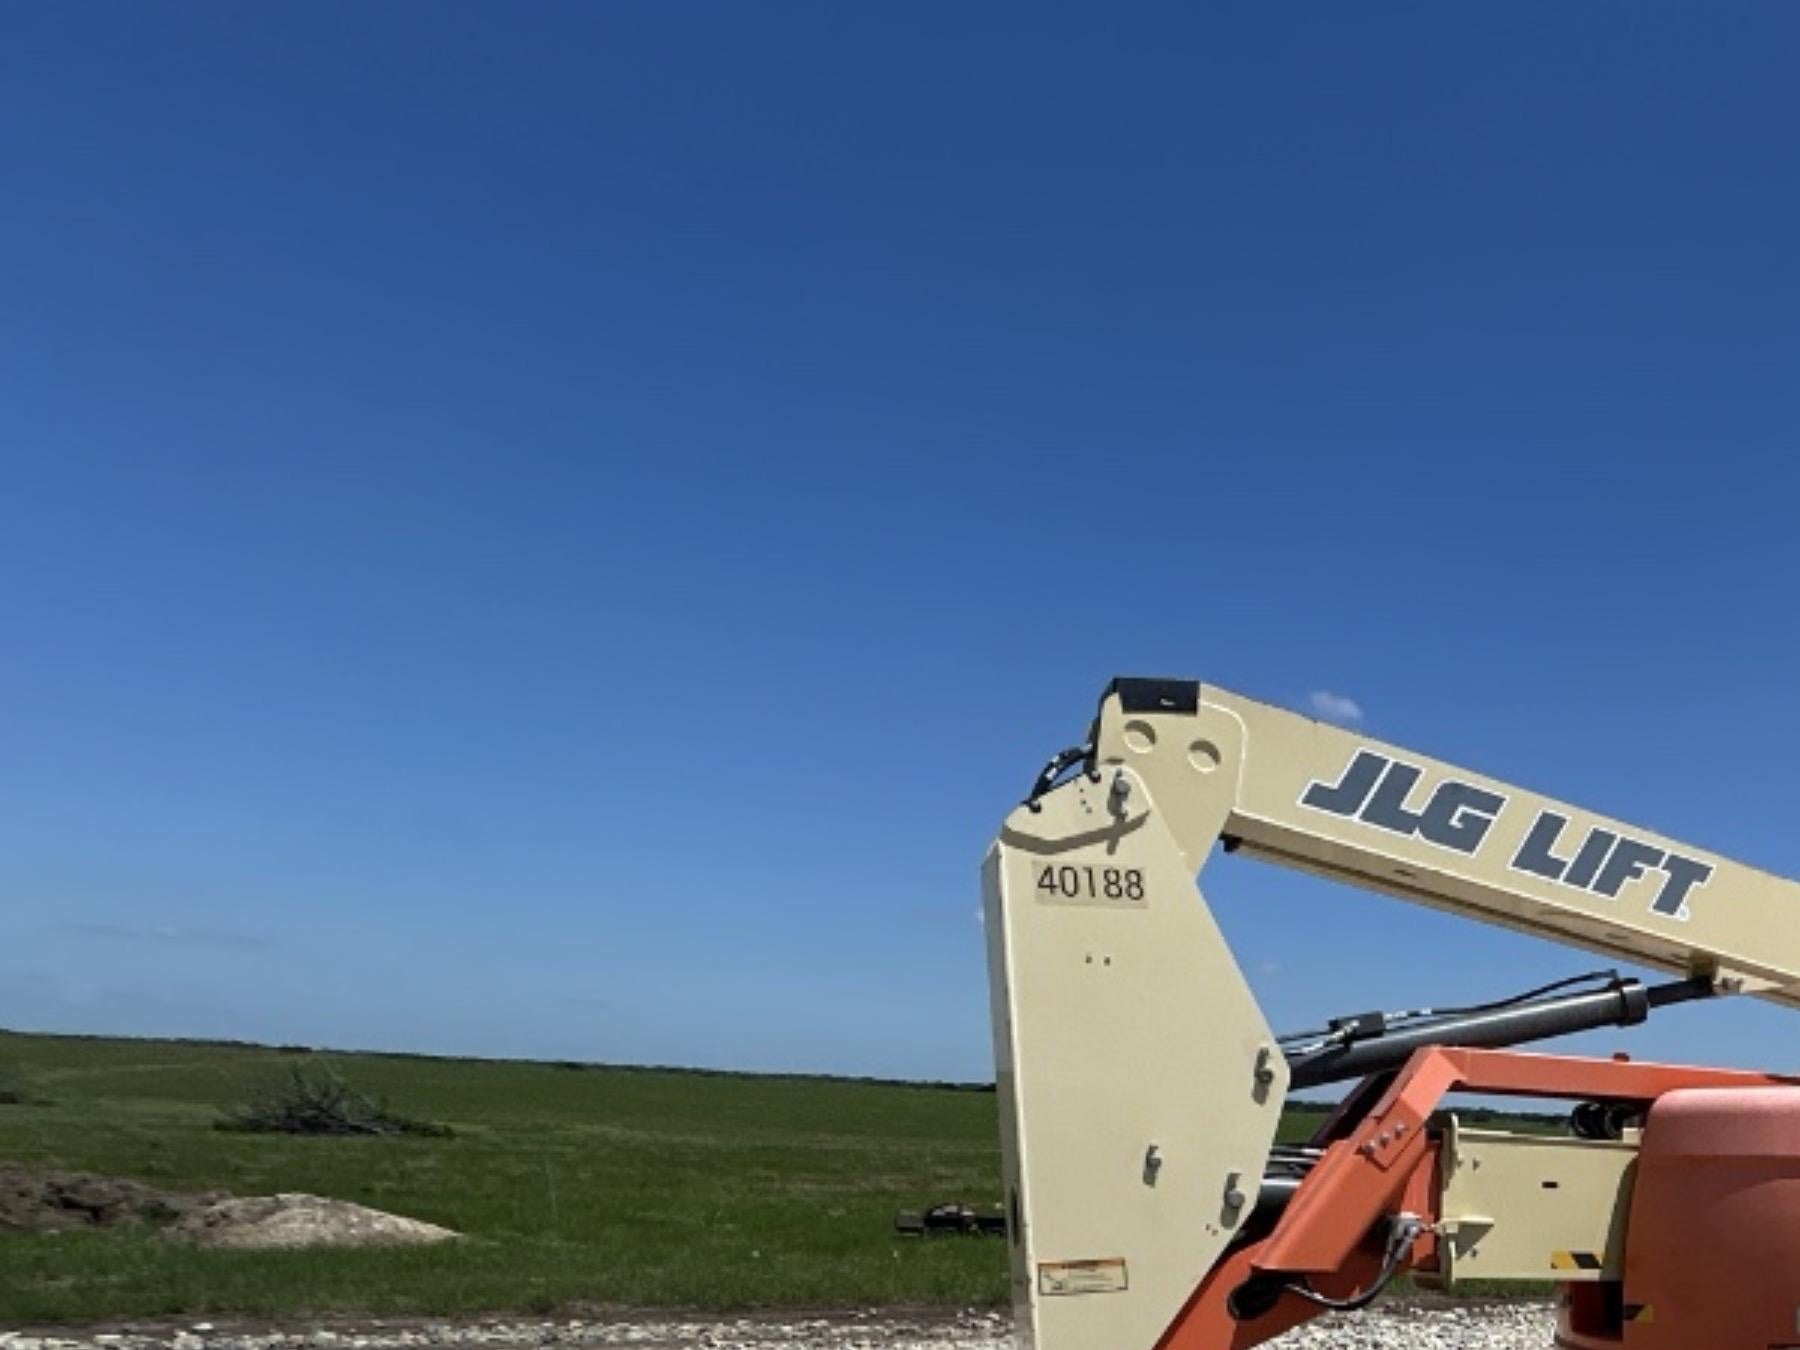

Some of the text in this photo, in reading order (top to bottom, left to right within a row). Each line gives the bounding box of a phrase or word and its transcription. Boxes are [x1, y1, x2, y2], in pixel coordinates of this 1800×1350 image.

[1038, 865, 1144, 901] 40188
[1301, 748, 1715, 919] JLG LIFT
